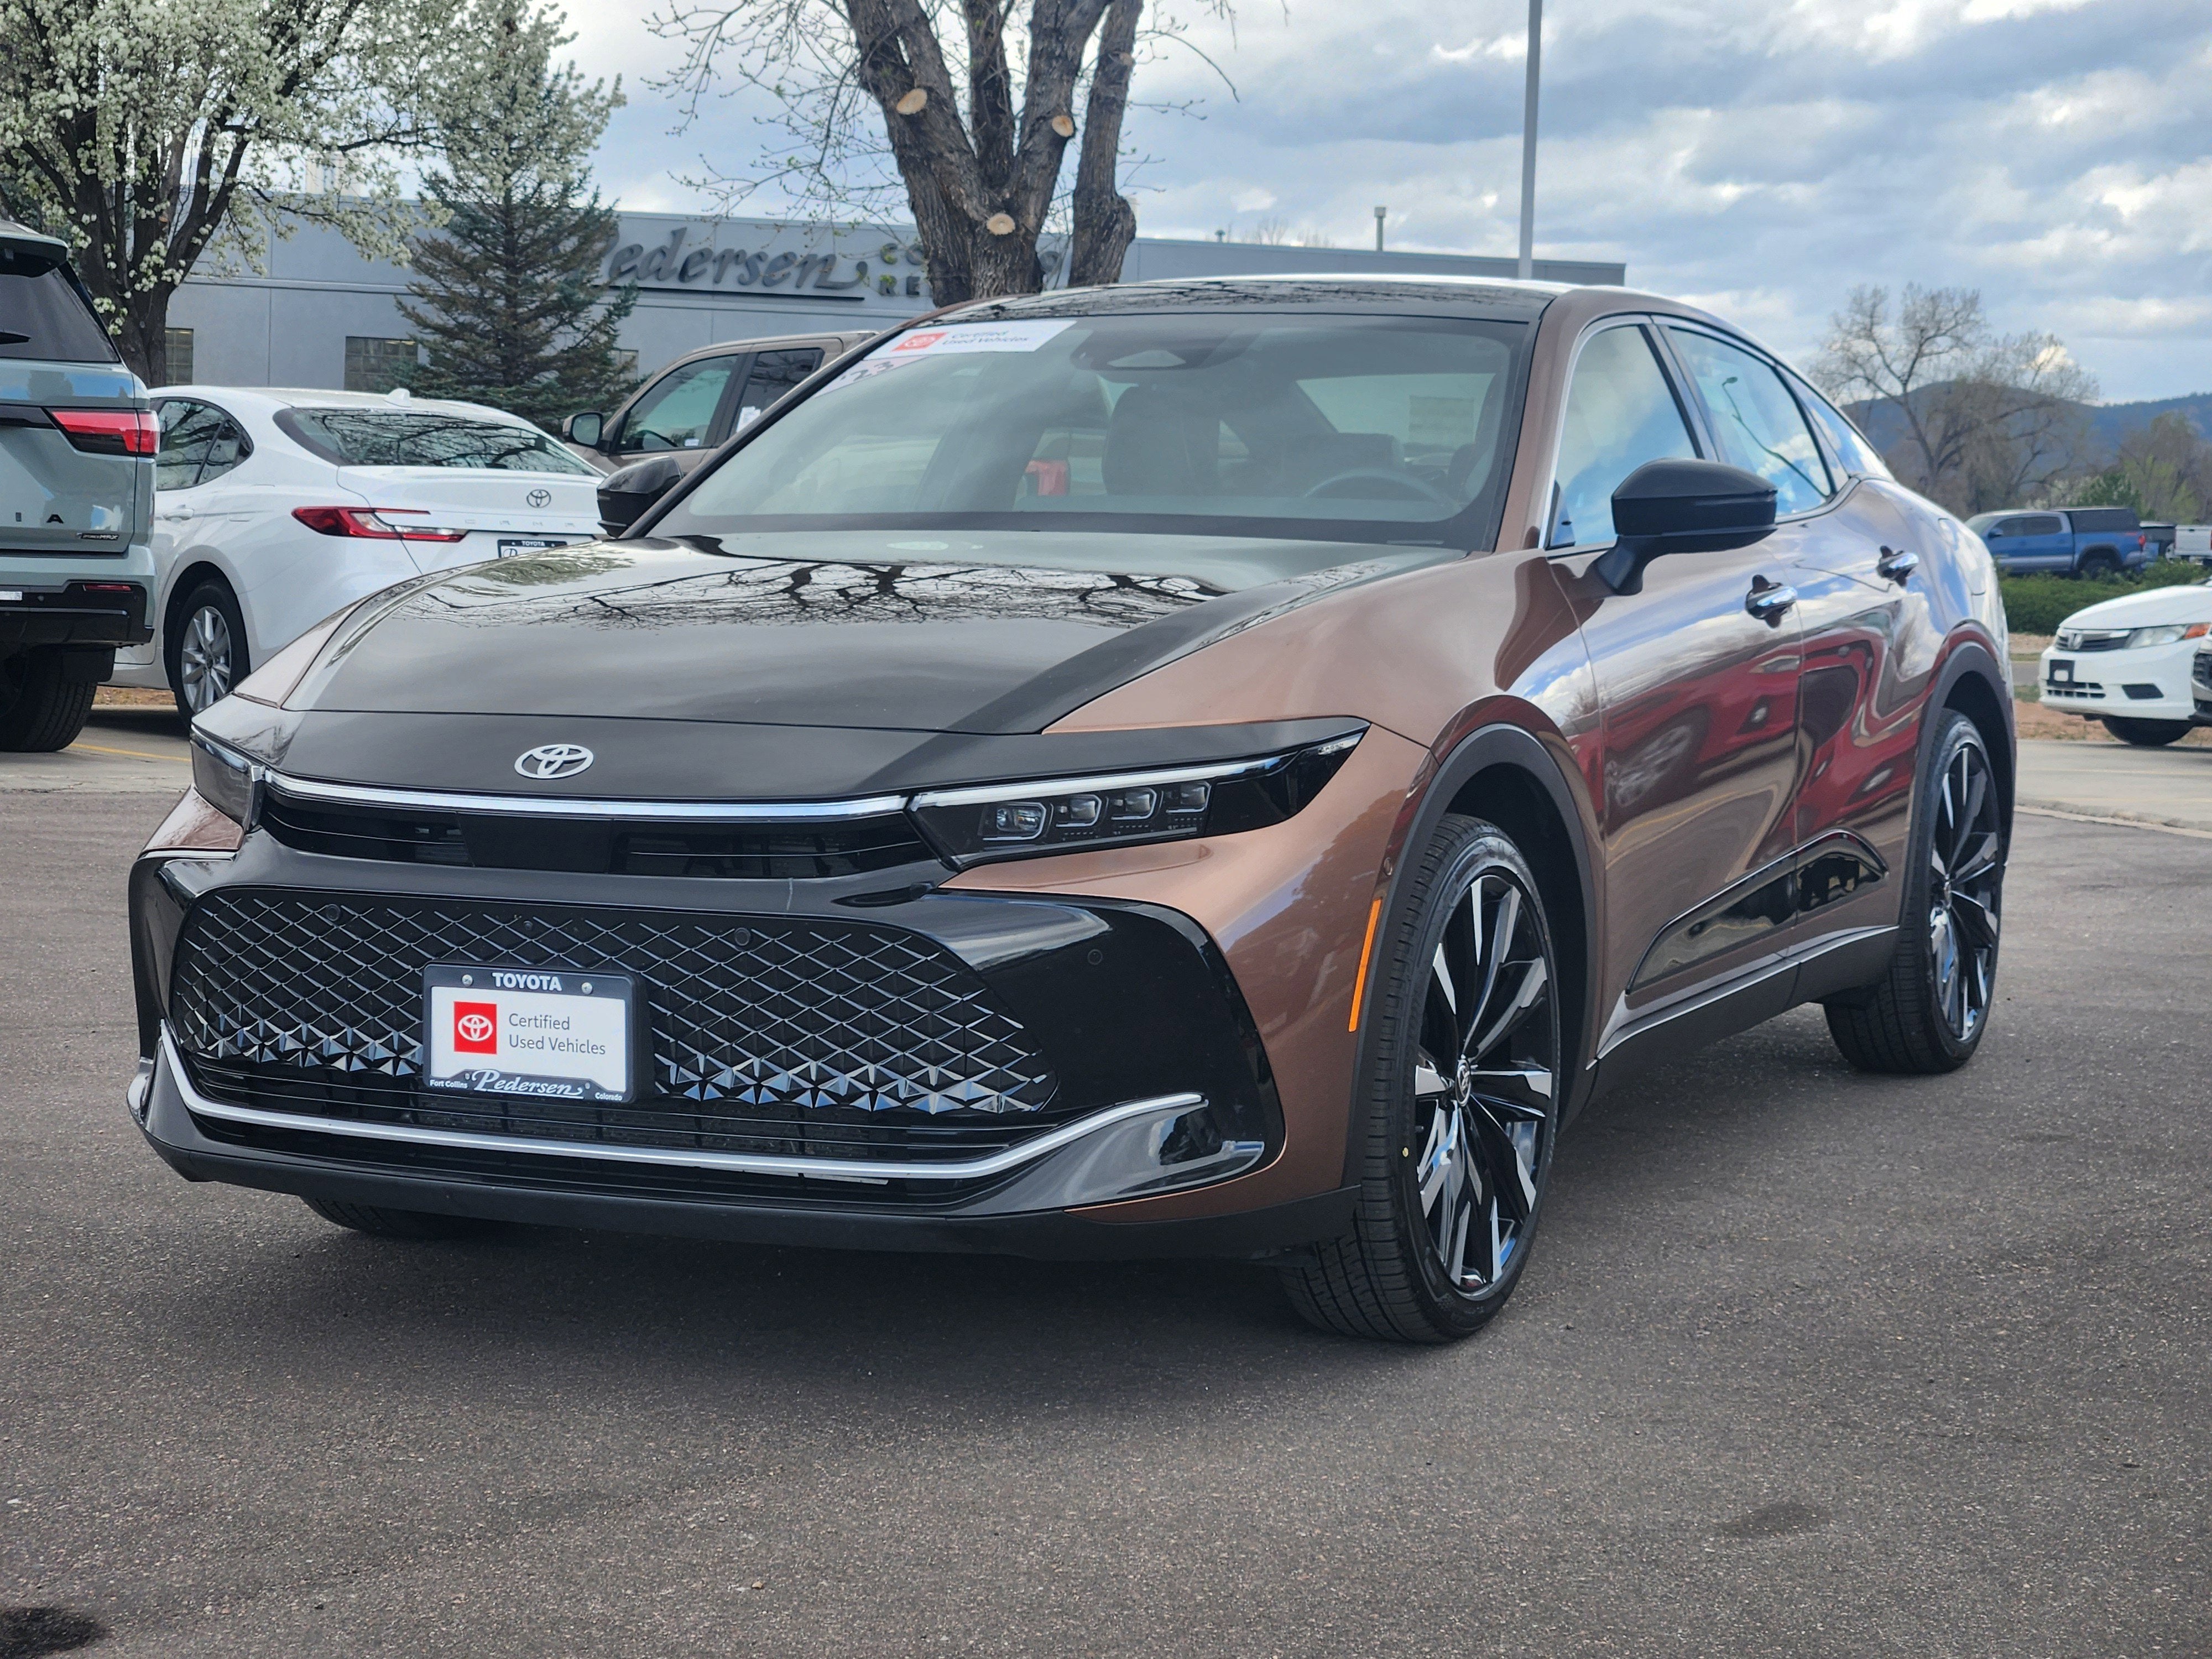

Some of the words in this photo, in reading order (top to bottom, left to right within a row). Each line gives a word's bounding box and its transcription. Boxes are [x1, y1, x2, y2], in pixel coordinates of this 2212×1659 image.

[465, 519, 575, 528] CAMR
[492, 972, 563, 992] TOYOTA
[508, 1013, 570, 1030] Certified
[509, 1034, 545, 1050] Used
[548, 1036, 606, 1055] Vehicles
[429, 1079, 444, 1087] Fort
[445, 1081, 468, 1089] Collins
[471, 1069, 584, 1096] Pedersen
[594, 1092, 623, 1101] Colorado
